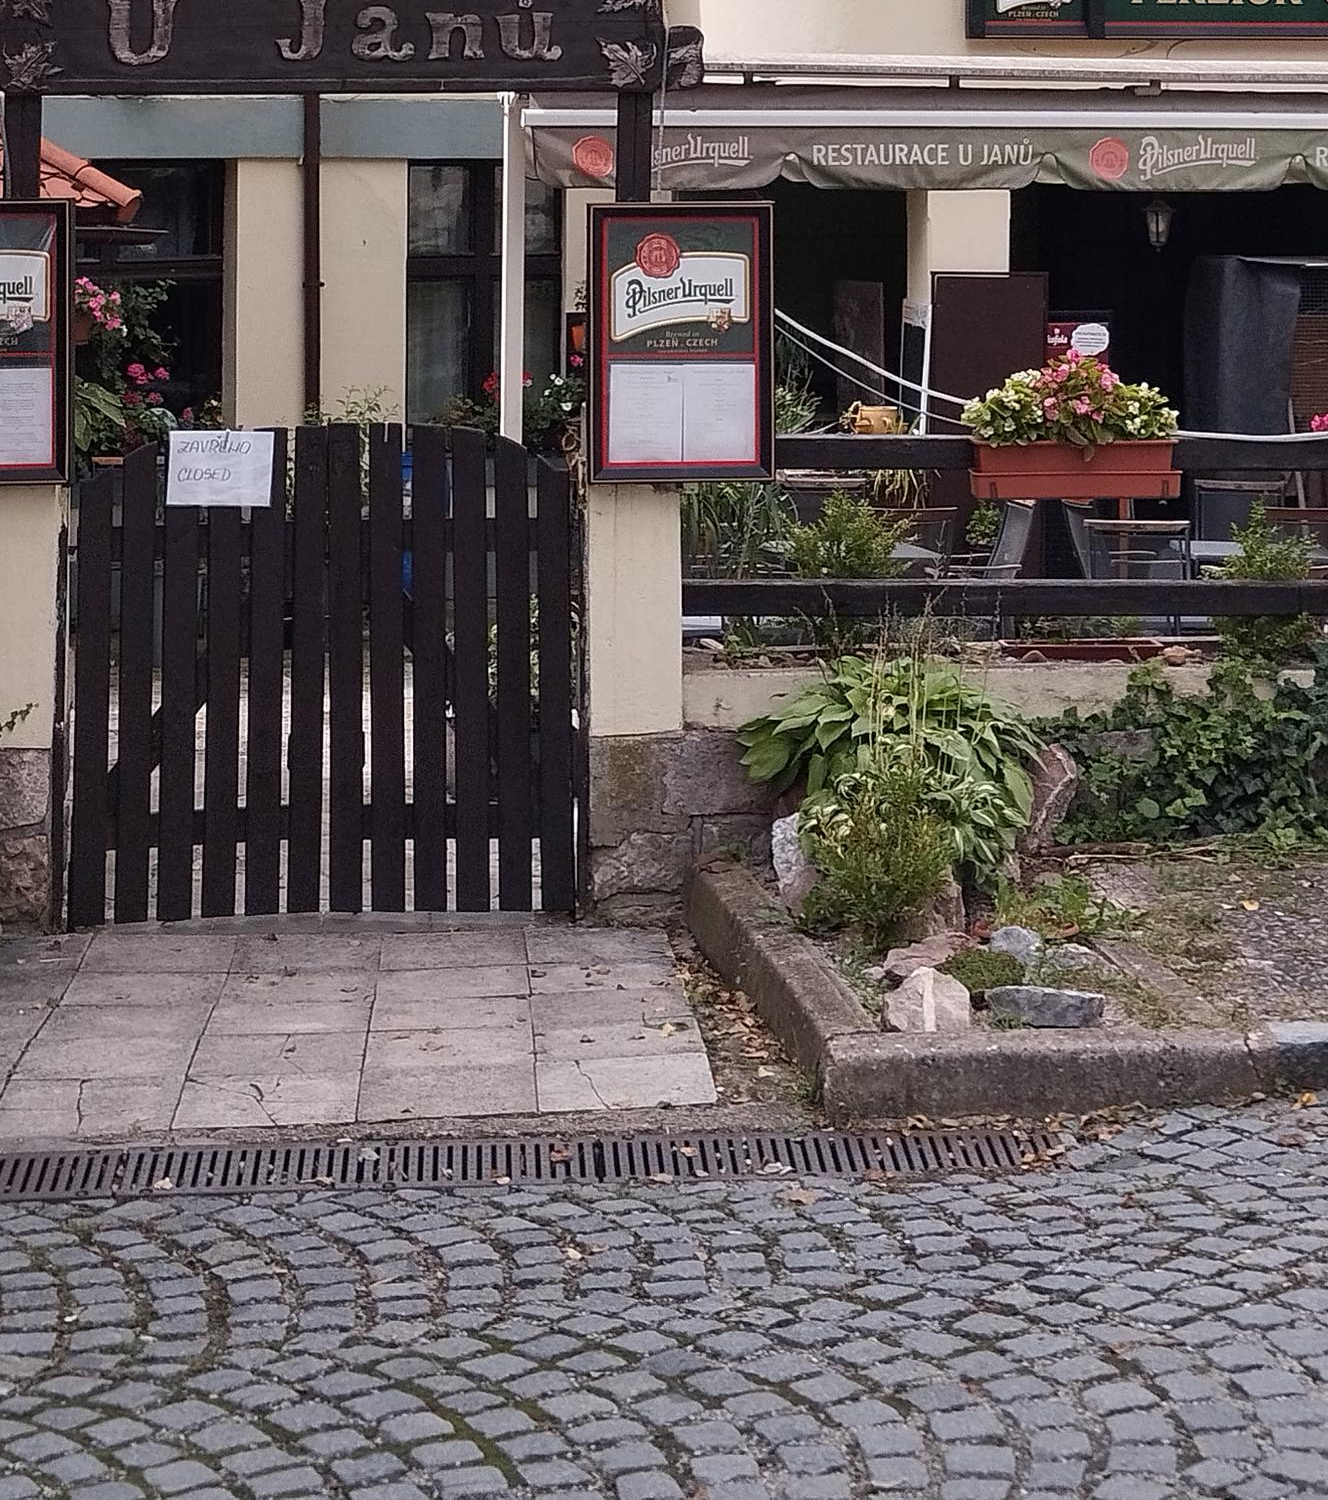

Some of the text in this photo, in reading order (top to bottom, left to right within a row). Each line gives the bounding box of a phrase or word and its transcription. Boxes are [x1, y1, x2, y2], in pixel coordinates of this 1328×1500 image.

[687, 133, 749, 167] Urquell
[812, 138, 1033, 166] RESTAURACE U JANŮ
[1138, 134, 1255, 180] Pilsner Urquell
[625, 277, 733, 318] Pilsner Urquell
[686, 338, 718, 347] CZECH
[177, 467, 232, 482] CLOSED
